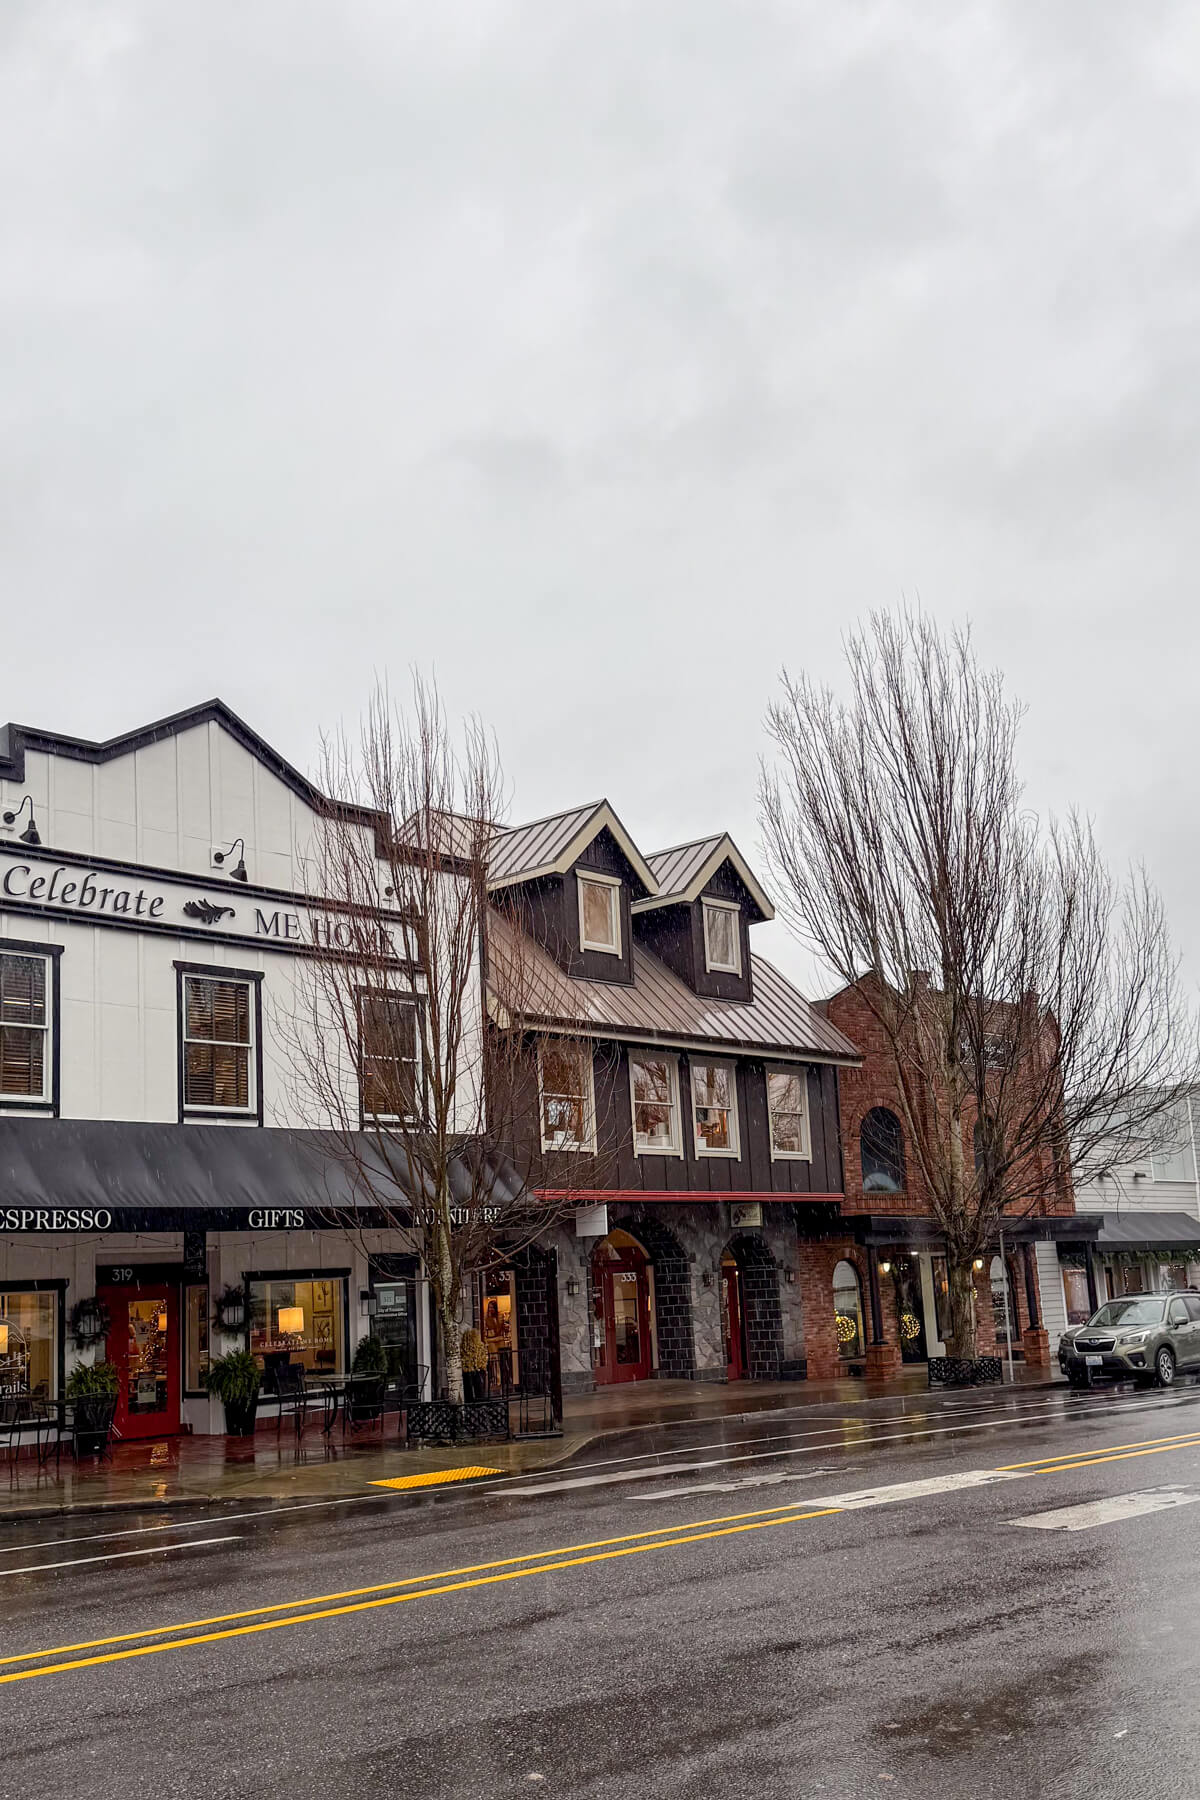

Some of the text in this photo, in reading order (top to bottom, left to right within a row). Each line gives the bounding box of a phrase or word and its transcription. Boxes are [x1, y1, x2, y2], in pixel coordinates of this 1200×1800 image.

[3, 865, 396, 955] Celebrate ME HOME
[248, 1209, 304, 1228] GIFTS
[413, 1207, 502, 1225] UNITRE
[112, 1268, 133, 1281] 319
[0, 1381, 28, 1395] rails
